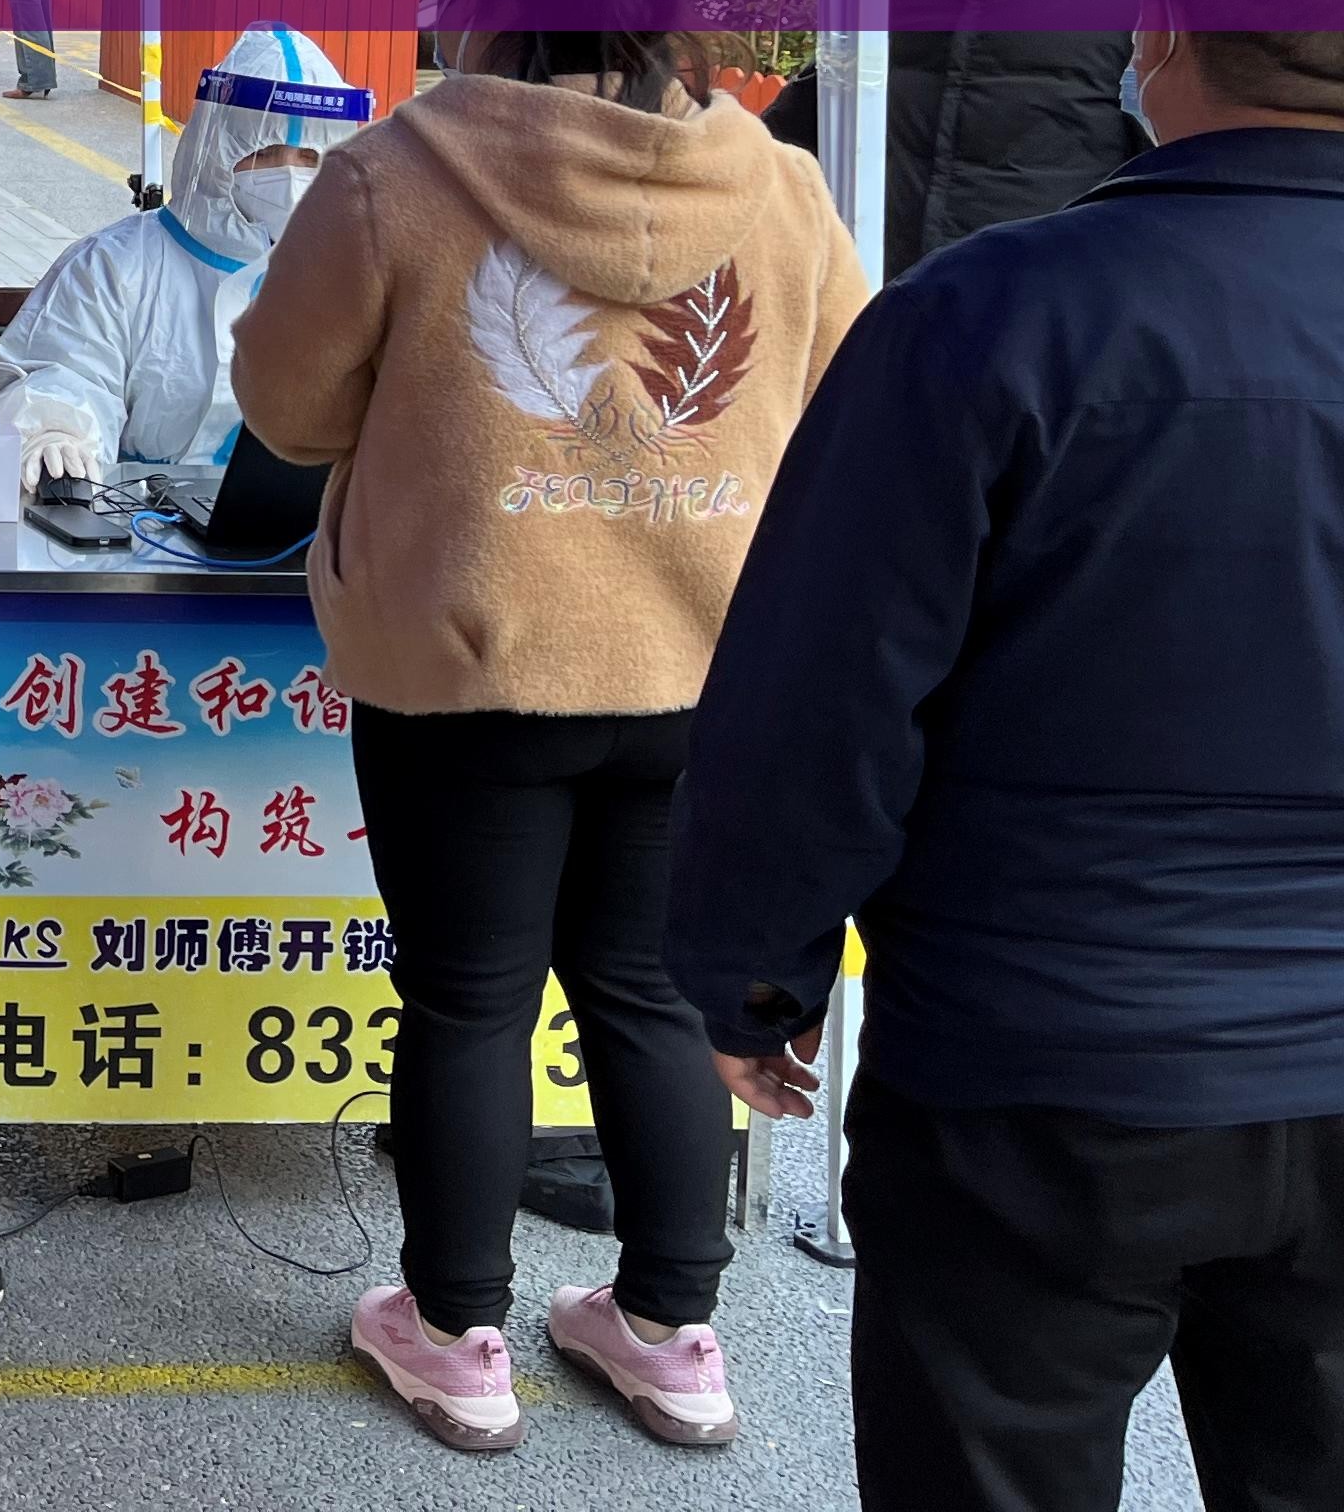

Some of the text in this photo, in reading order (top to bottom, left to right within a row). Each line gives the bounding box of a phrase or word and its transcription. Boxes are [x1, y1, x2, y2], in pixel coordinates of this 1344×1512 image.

[2, 652, 353, 738] 创建和谐
[91, 917, 398, 973] 刘师傅开锁
